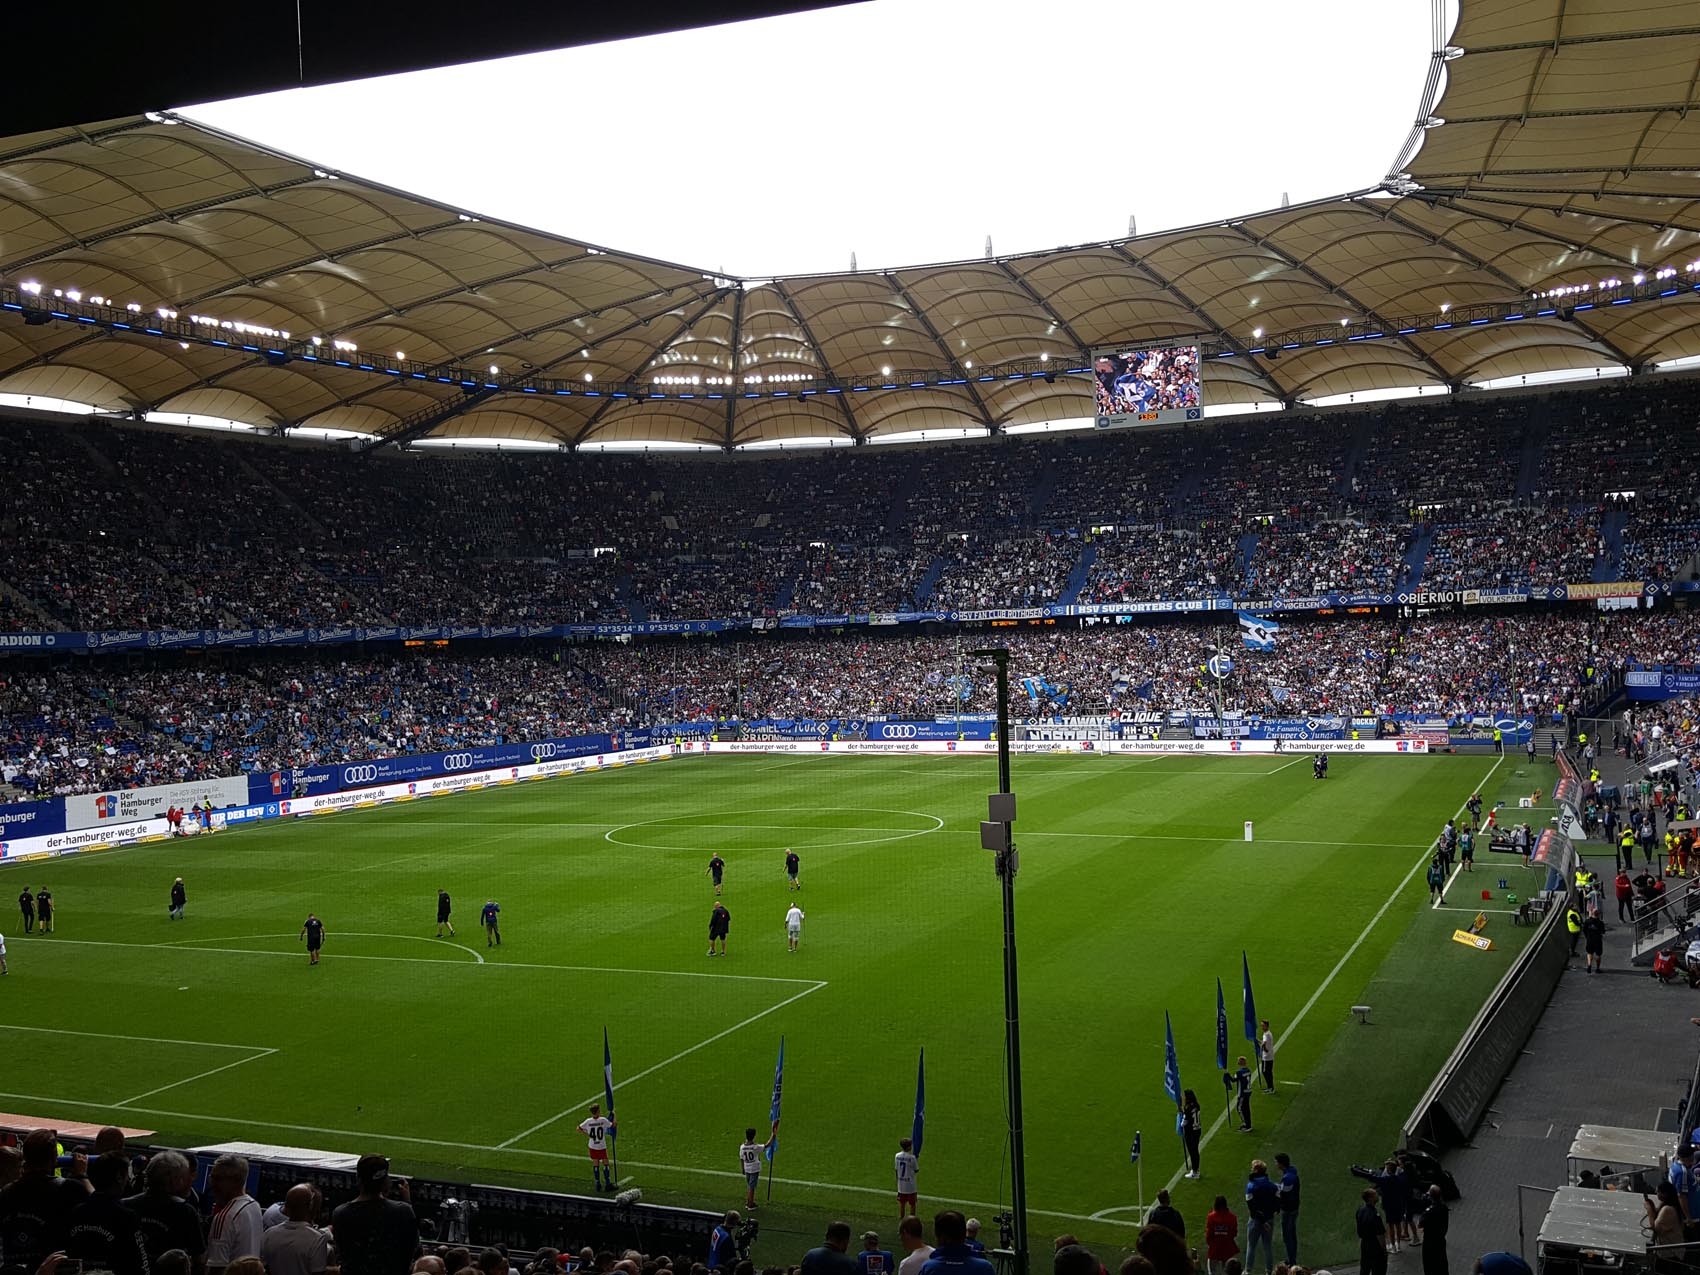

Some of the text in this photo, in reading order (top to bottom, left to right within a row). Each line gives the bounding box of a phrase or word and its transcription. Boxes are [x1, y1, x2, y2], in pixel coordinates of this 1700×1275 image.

[1409, 592, 1462, 604] BIERNOT
[1078, 600, 1204, 614] HSV SUPPORTERS CLUB
[974, 610, 988, 620] FAN
[1120, 712, 1163, 723] CLIQUE
[730, 743, 797, 751] der-hamburger-weg.de
[848, 743, 918, 751] der-hamburger-weg.de
[1120, 742, 1205, 752] der-hamburger-weg.de
[618, 748, 660, 760] der-hamburger-weg.de
[378, 769, 402, 777] Vorsprung
[416, 765, 432, 773] Technik
[537, 760, 586, 773] der-hamburger-weg.de
[292, 770, 304, 778] Der
[292, 774, 330, 786] Hamburger
[432, 774, 491, 788] der-hamburger-weg.de
[120, 796, 163, 808] Hamburger
[314, 789, 386, 807] der-hamburger-weg.de
[121, 808, 138, 817] Weg
[227, 810, 245, 821] DER
[246, 806, 264, 818] HSV
[46, 825, 148, 848] der-hamburger-weg.de
[590, 1127, 604, 1141] 40
[744, 1151, 754, 1162] 10
[900, 1162, 906, 1177] 7
[84, 1224, 116, 1242] Hamburg
